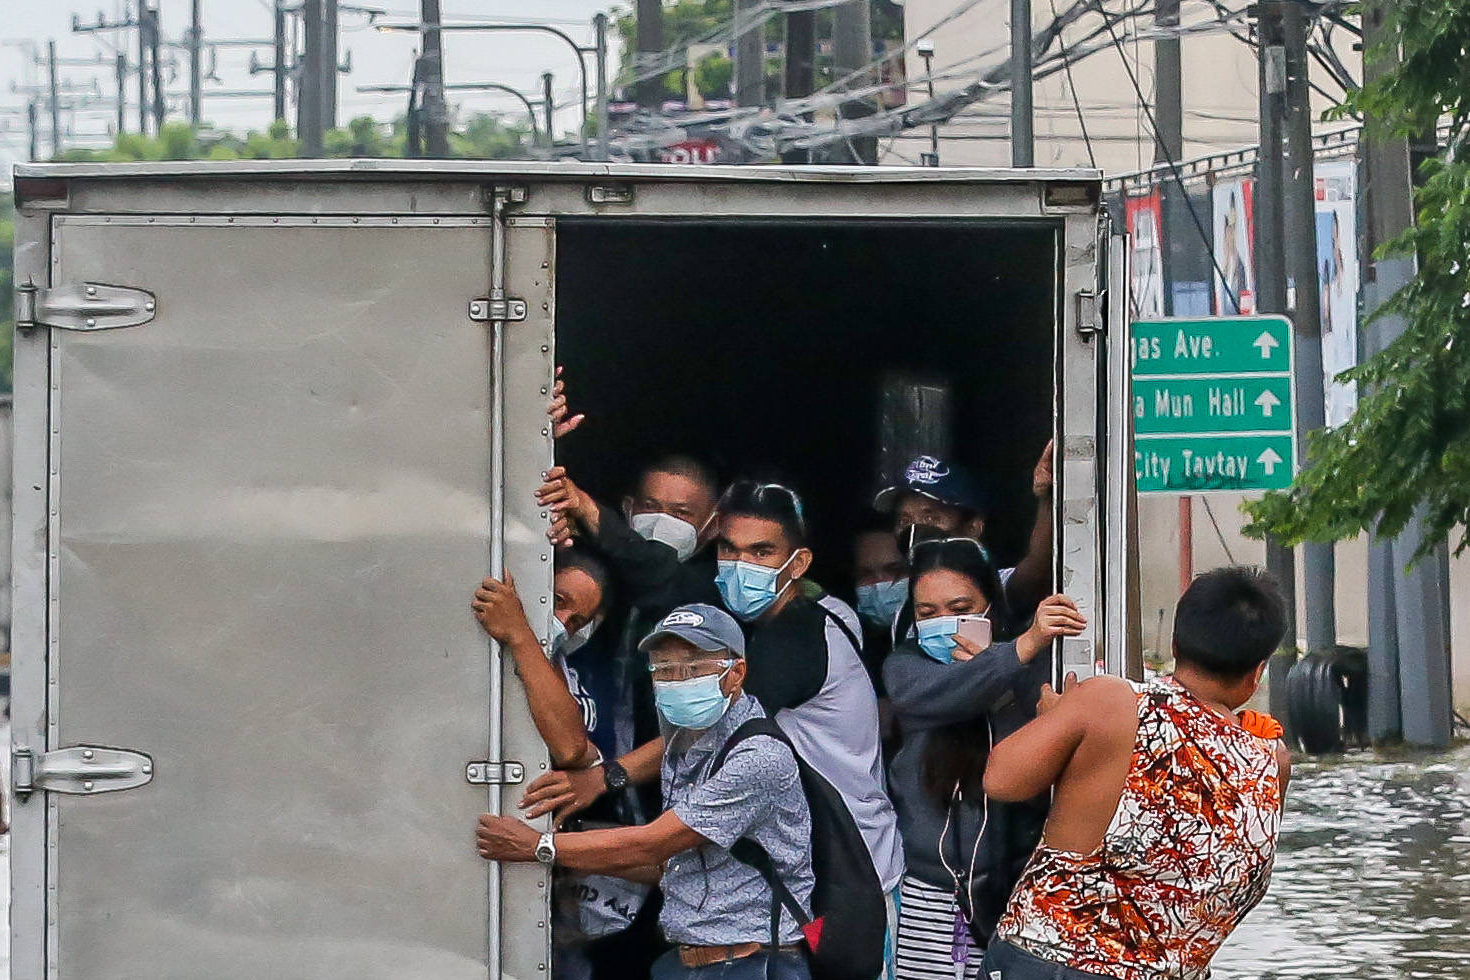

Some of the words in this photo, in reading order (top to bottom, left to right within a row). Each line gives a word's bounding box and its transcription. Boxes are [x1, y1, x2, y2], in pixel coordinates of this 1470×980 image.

[1174, 329, 1220, 359] Ave.
[1155, 388, 1193, 418] Mun
[1209, 387, 1245, 417] Hall
